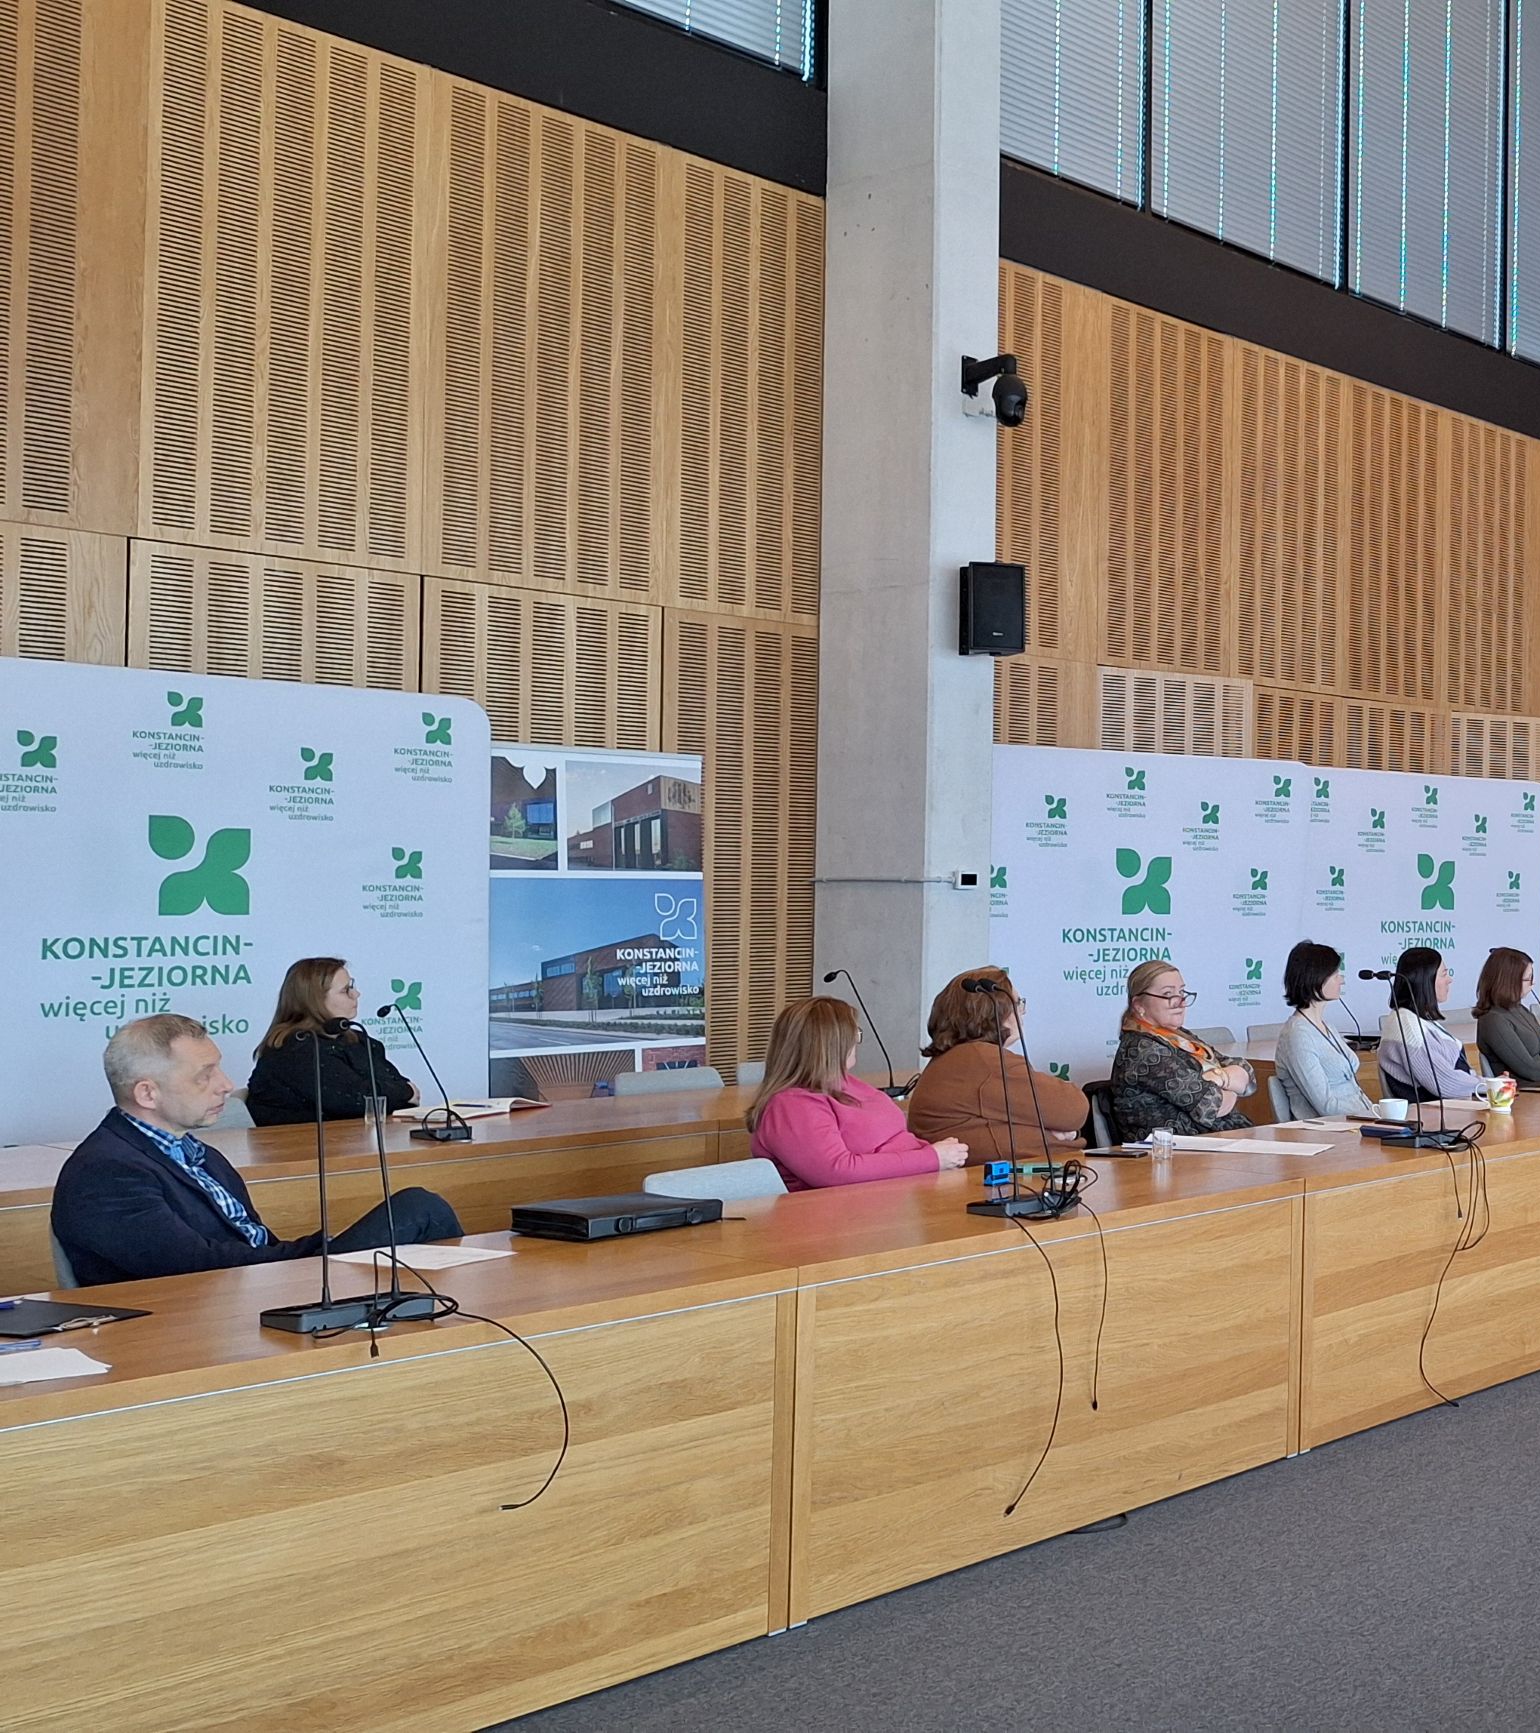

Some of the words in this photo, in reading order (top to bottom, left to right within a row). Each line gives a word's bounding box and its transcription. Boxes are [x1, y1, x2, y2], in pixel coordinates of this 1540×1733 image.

[132, 730, 205, 742] KONSTANCIN-
[149, 742, 204, 752] -JEZIORNA
[394, 747, 453, 757] KONSTANCIN-
[132, 751, 160, 760] więcej
[163, 752, 176, 760] niż
[153, 759, 203, 770] uzdrowisko
[408, 758, 453, 767] -JEZIORNA
[269, 784, 334, 795] KONSTANCIN-
[285, 795, 334, 805] -JEZIORNA
[362, 884, 424, 893] KONSTANCIN-
[377, 894, 423, 902] -JEZIORNA
[1380, 920, 1456, 934] KONSTANCIN-
[1062, 927, 1173, 944] KONSTANCIN-
[41, 934, 254, 961] KONSTANCIN-
[616, 947, 700, 960] KONSTANCIN-
[1088, 946, 1172, 963] -JEZIORNA
[635, 961, 700, 973] -JEZIORNA
[91, 963, 252, 989] -JEZIORNA
[617, 974, 651, 987] więcej
[653, 973, 668, 984] niż
[1063, 965, 1107, 983] więcej
[1110, 965, 1129, 979] niż
[641, 985, 700, 996] uzdrowisko
[40, 993, 126, 1021] więcej
[135, 991, 171, 1013] niż
